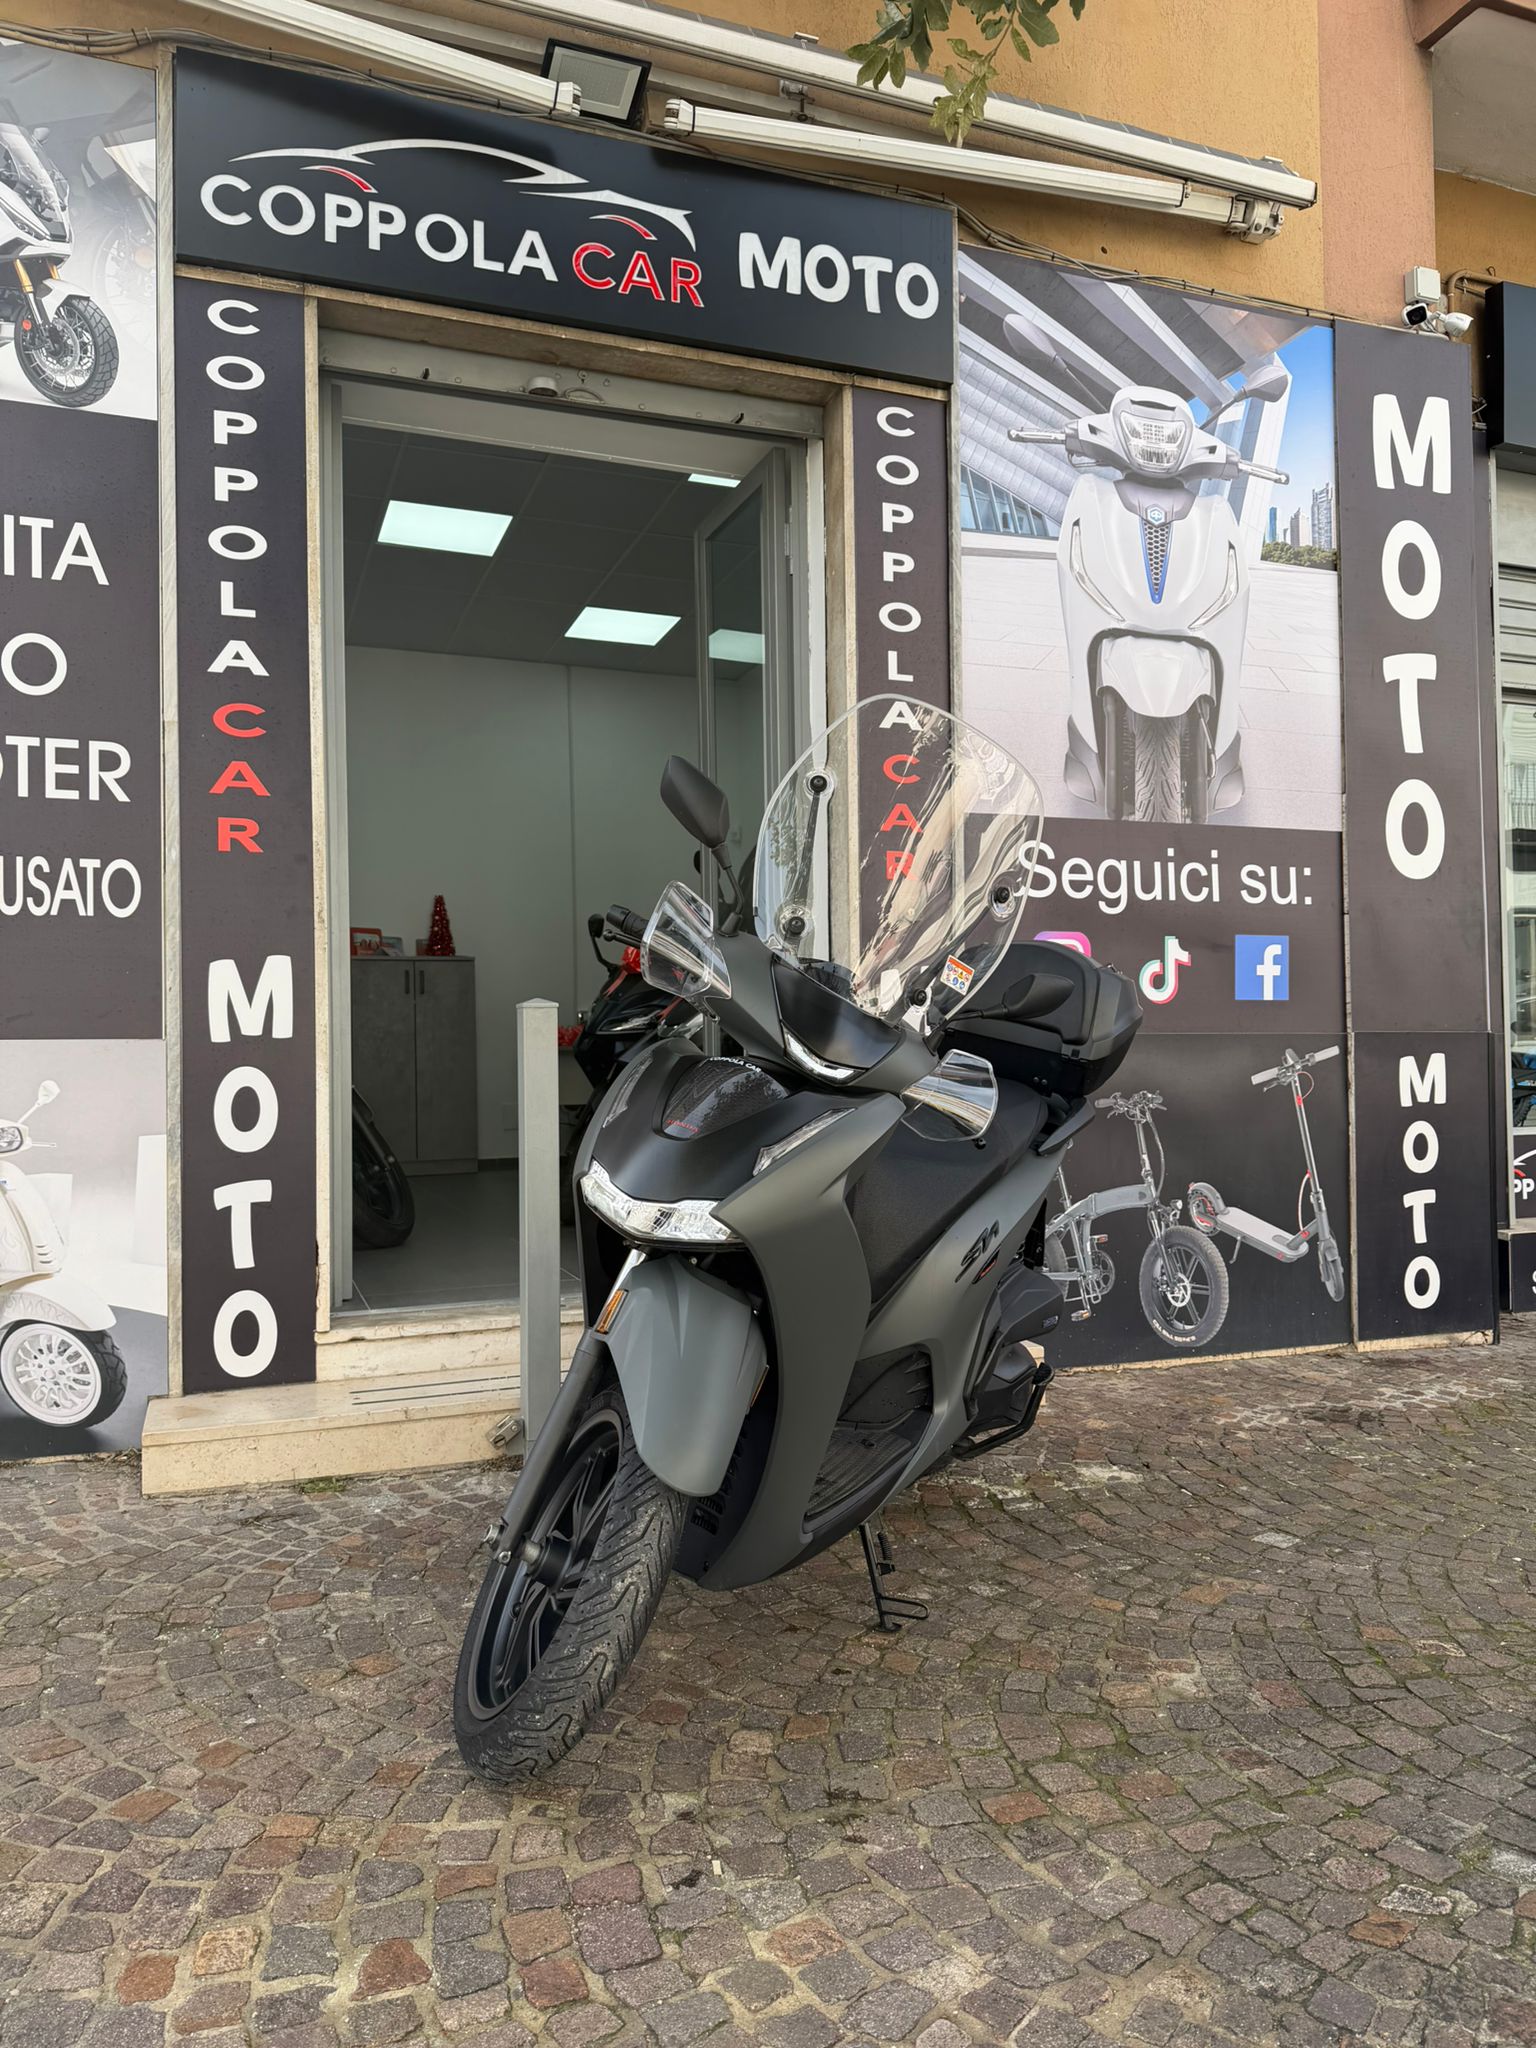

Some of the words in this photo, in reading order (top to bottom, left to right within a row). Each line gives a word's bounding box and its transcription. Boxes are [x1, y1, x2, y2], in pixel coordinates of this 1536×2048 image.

[200, 174, 559, 282] COPPOLA
[571, 243, 704, 308] CAR
[738, 232, 940, 320] MOTO
[3, 513, 110, 586] ITA
[205, 299, 270, 678] COPPOLA
[875, 405, 923, 731] COPPOLA
[1372, 393, 1453, 881] MOTO
[0, 632, 68, 696] O
[0, 734, 132, 803] TER
[209, 702, 270, 856] CAR
[0, 855, 142, 919] USATO
[1014, 840, 1220, 915] Seguici
[1240, 863, 1313, 907] su:
[207, 954, 294, 1379] MOTO
[1398, 1052, 1448, 1310] MOTO
